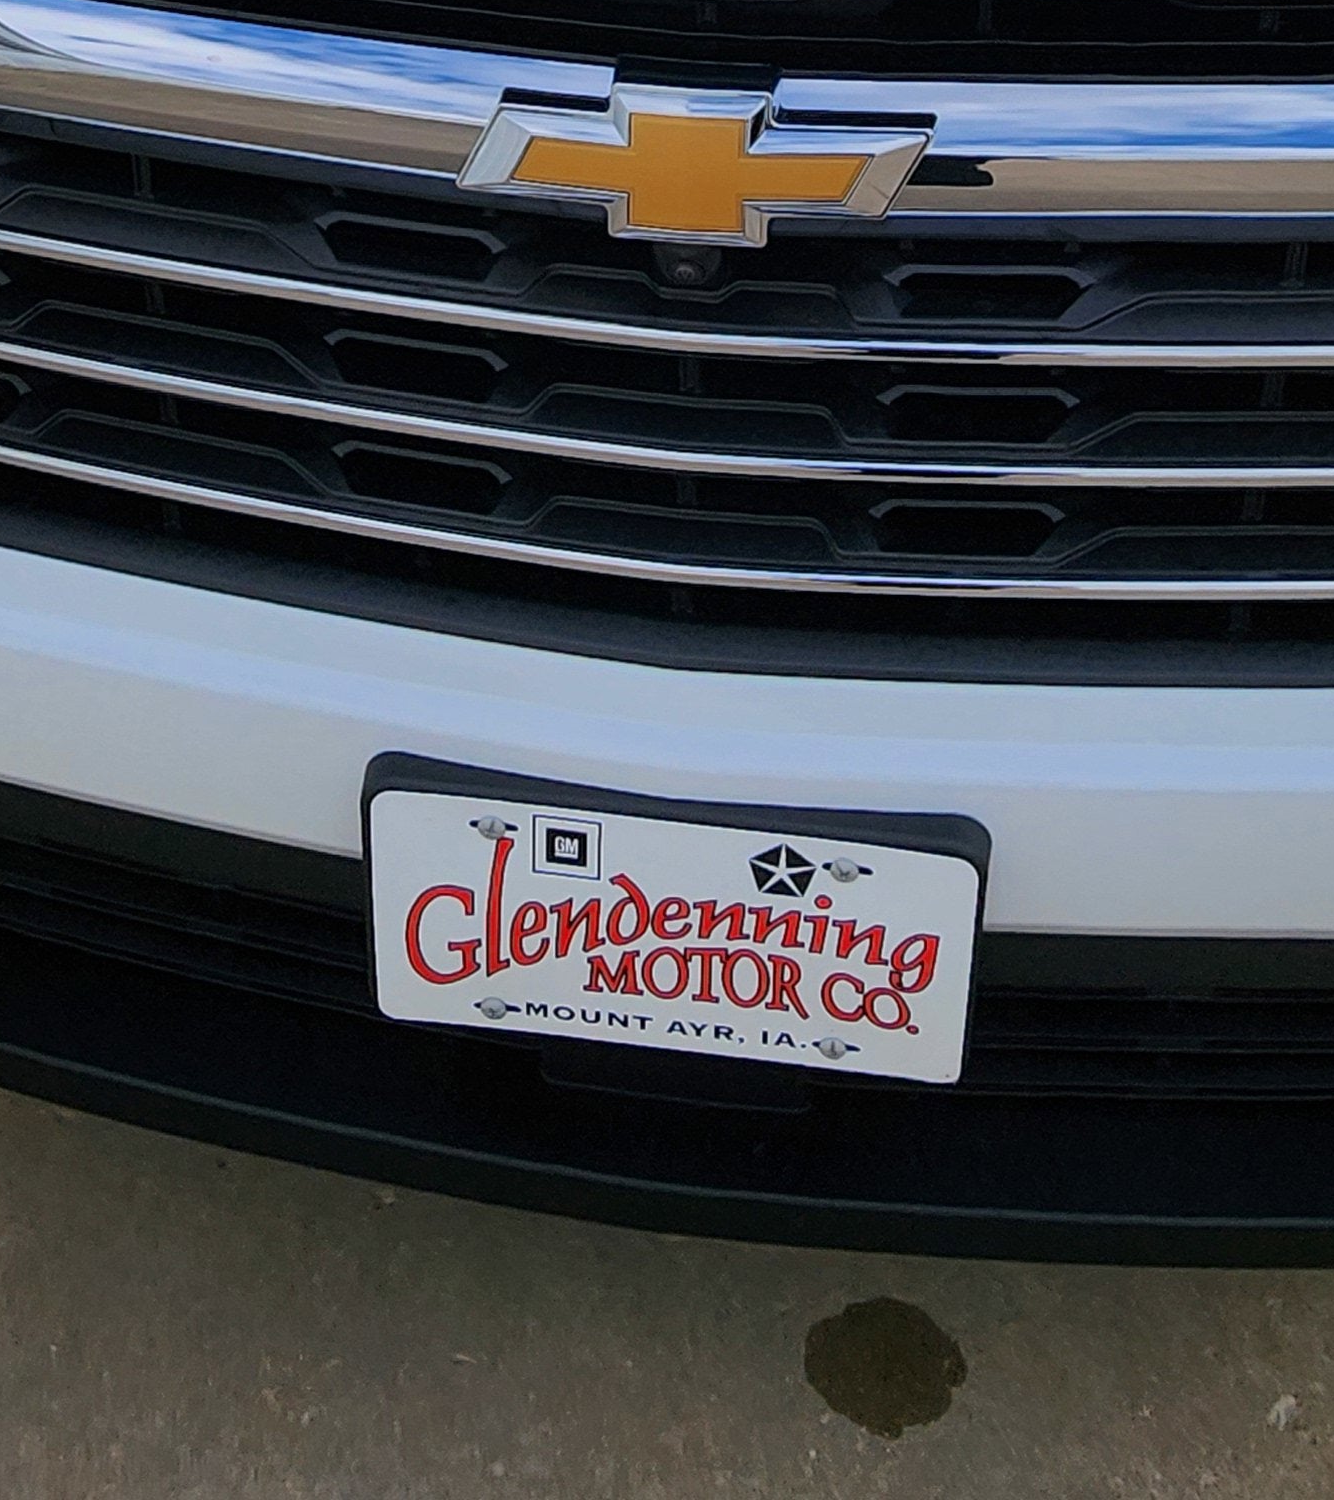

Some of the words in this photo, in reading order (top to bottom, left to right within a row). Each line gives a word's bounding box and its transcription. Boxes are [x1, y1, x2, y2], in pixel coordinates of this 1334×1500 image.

[553, 835, 579, 860] GM
[404, 836, 941, 993] Glendenning
[524, 1000, 654, 1032] MOUNT
[666, 1018, 746, 1046] AYR,
[761, 1029, 808, 1050] IA.
[582, 946, 810, 1020] MOTOR
[820, 971, 921, 1036] CO.
